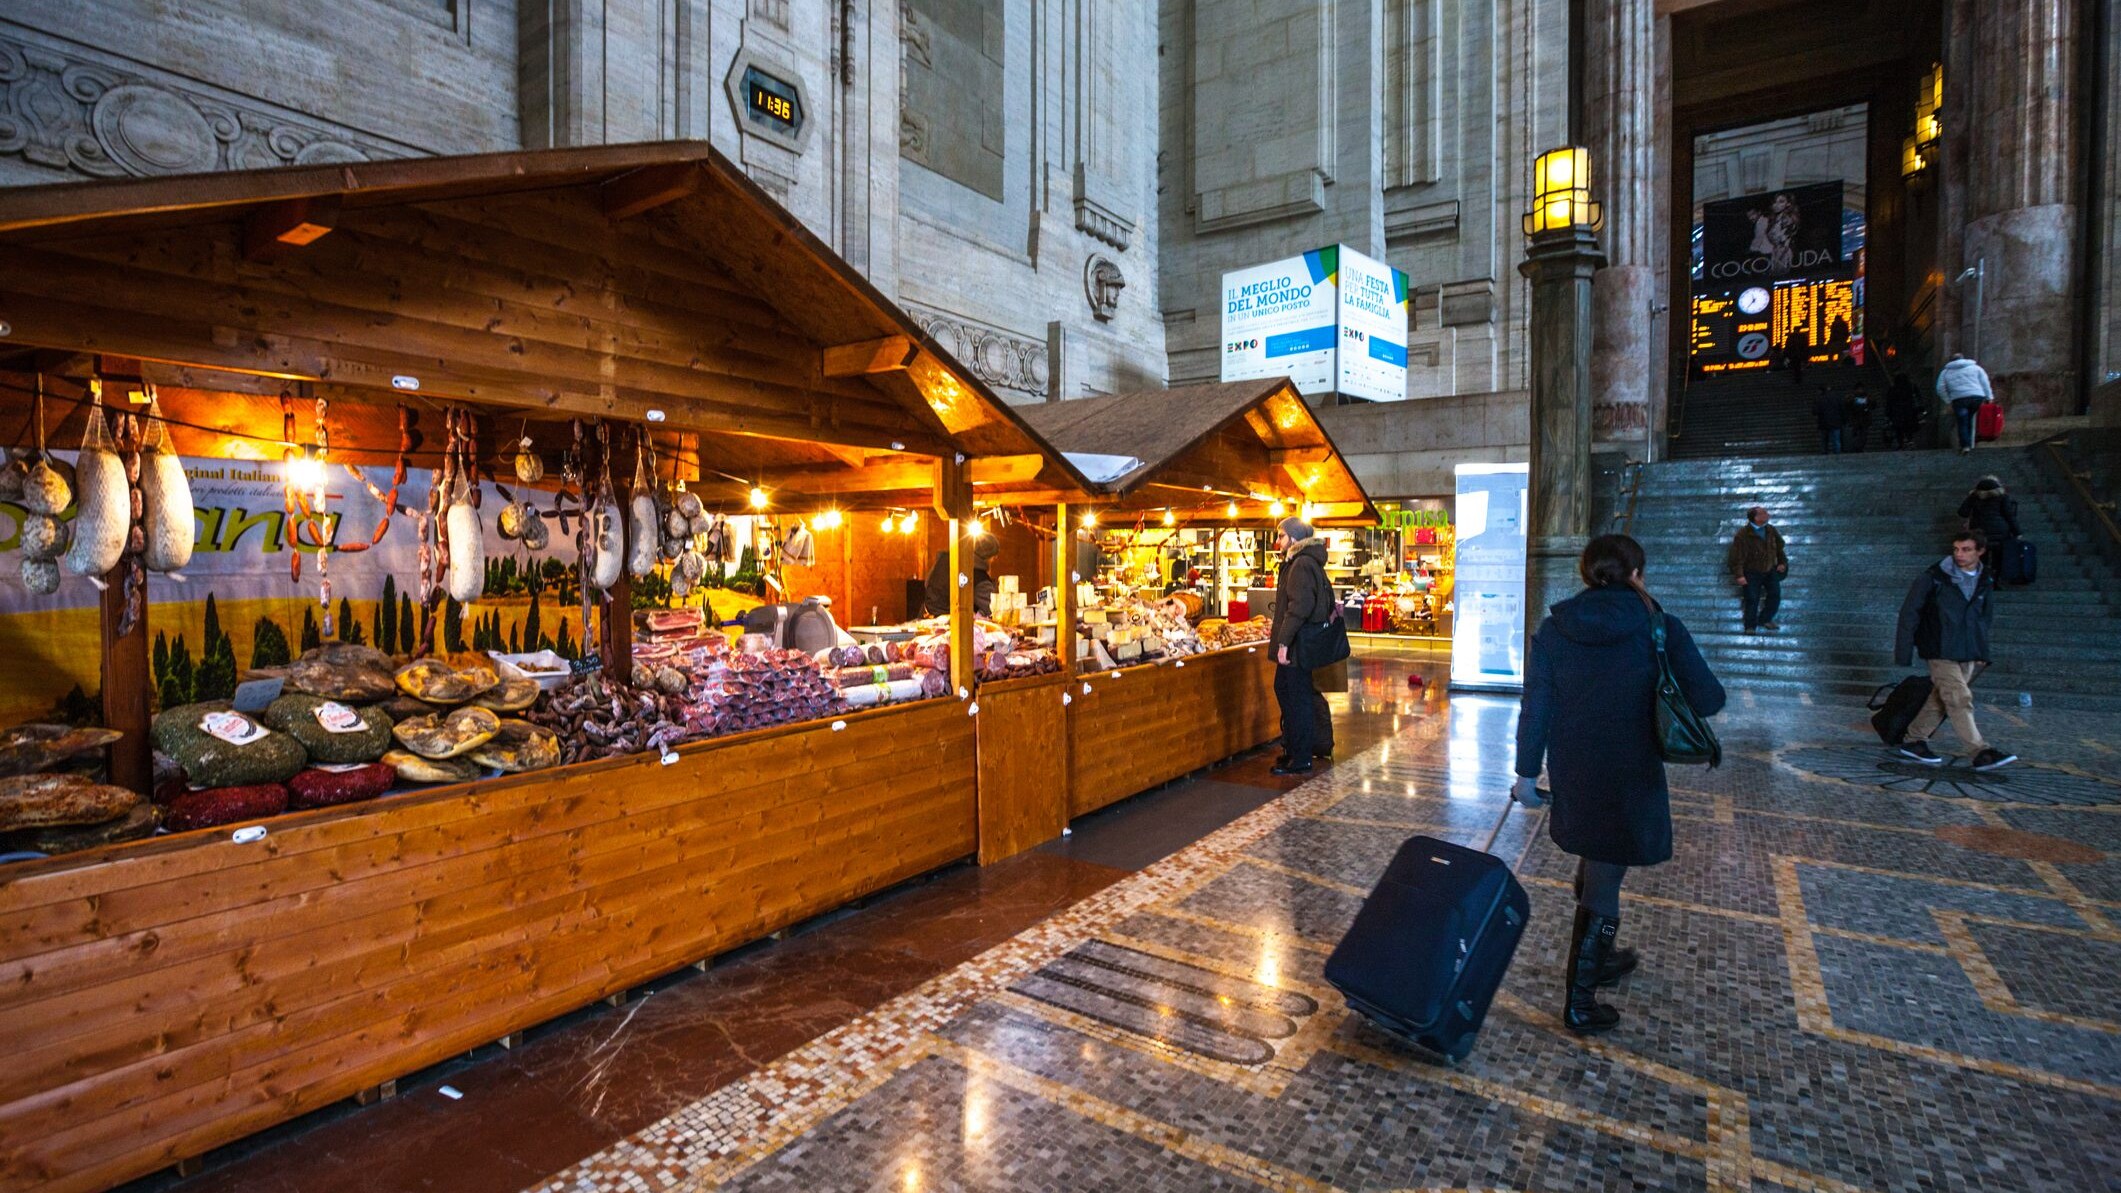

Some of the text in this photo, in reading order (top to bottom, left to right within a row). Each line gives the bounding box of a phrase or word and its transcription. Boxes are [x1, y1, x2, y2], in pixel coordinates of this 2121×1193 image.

[758, 91, 791, 120] 11:36
[1228, 276, 1291, 301] IL MEGLIO
[1366, 274, 1390, 295] FESTA
[1228, 285, 1312, 314] DEL MONDO
[1344, 293, 1354, 306] LA
[1360, 286, 1384, 305] TUTTA
[1252, 306, 1280, 318] UNICO
[1343, 326, 1365, 342] EXPO
[1227, 338, 1258, 353] EXPO
[229, 468, 281, 482] Italian
